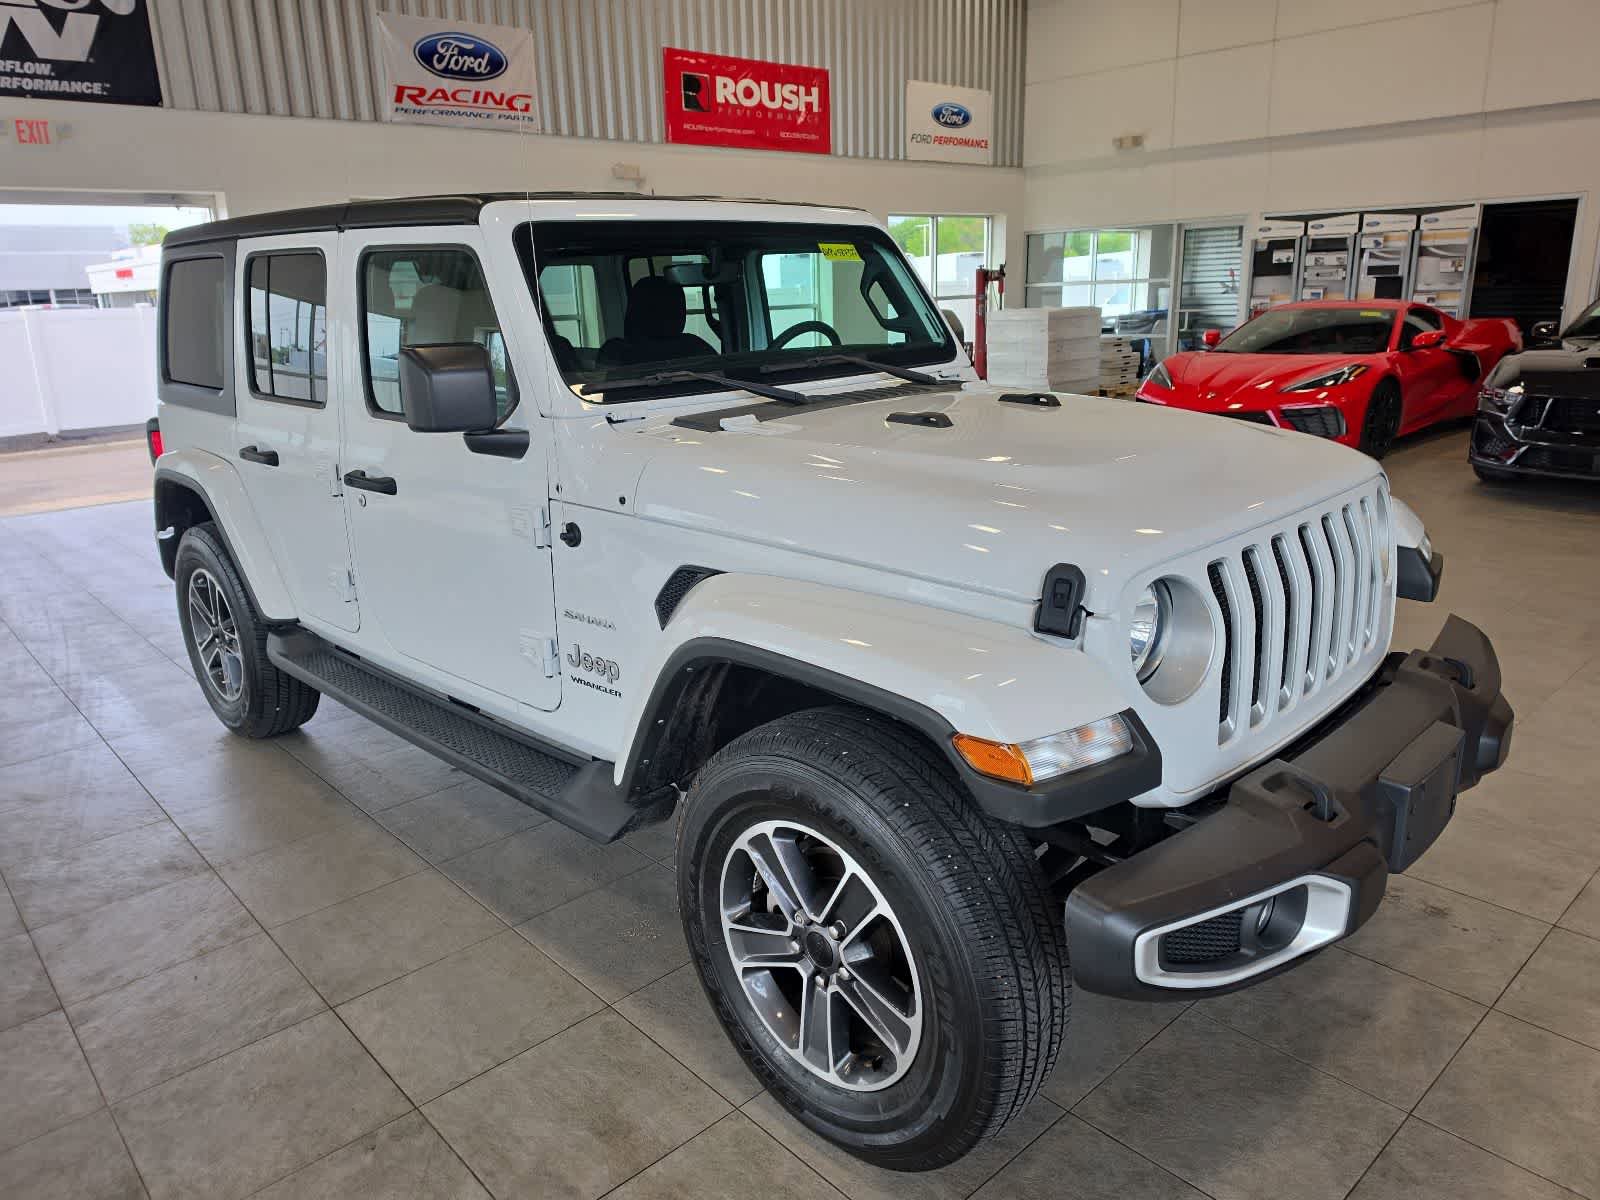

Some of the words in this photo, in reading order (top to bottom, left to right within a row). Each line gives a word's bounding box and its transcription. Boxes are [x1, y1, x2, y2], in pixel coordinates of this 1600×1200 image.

[432, 39, 491, 74] Ford
[393, 84, 532, 112] RACING
[715, 75, 819, 113] ROUSH
[394, 106, 495, 120] PERFORMANCE
[498, 113, 534, 122] PARTS
[940, 106, 966, 125] Ford
[15, 119, 51, 144] EXIT
[911, 133, 932, 144] FORD
[933, 135, 989, 149] PERFORMANCE
[566, 642, 620, 685] Jeep
[570, 674, 623, 698] WRANGLER
